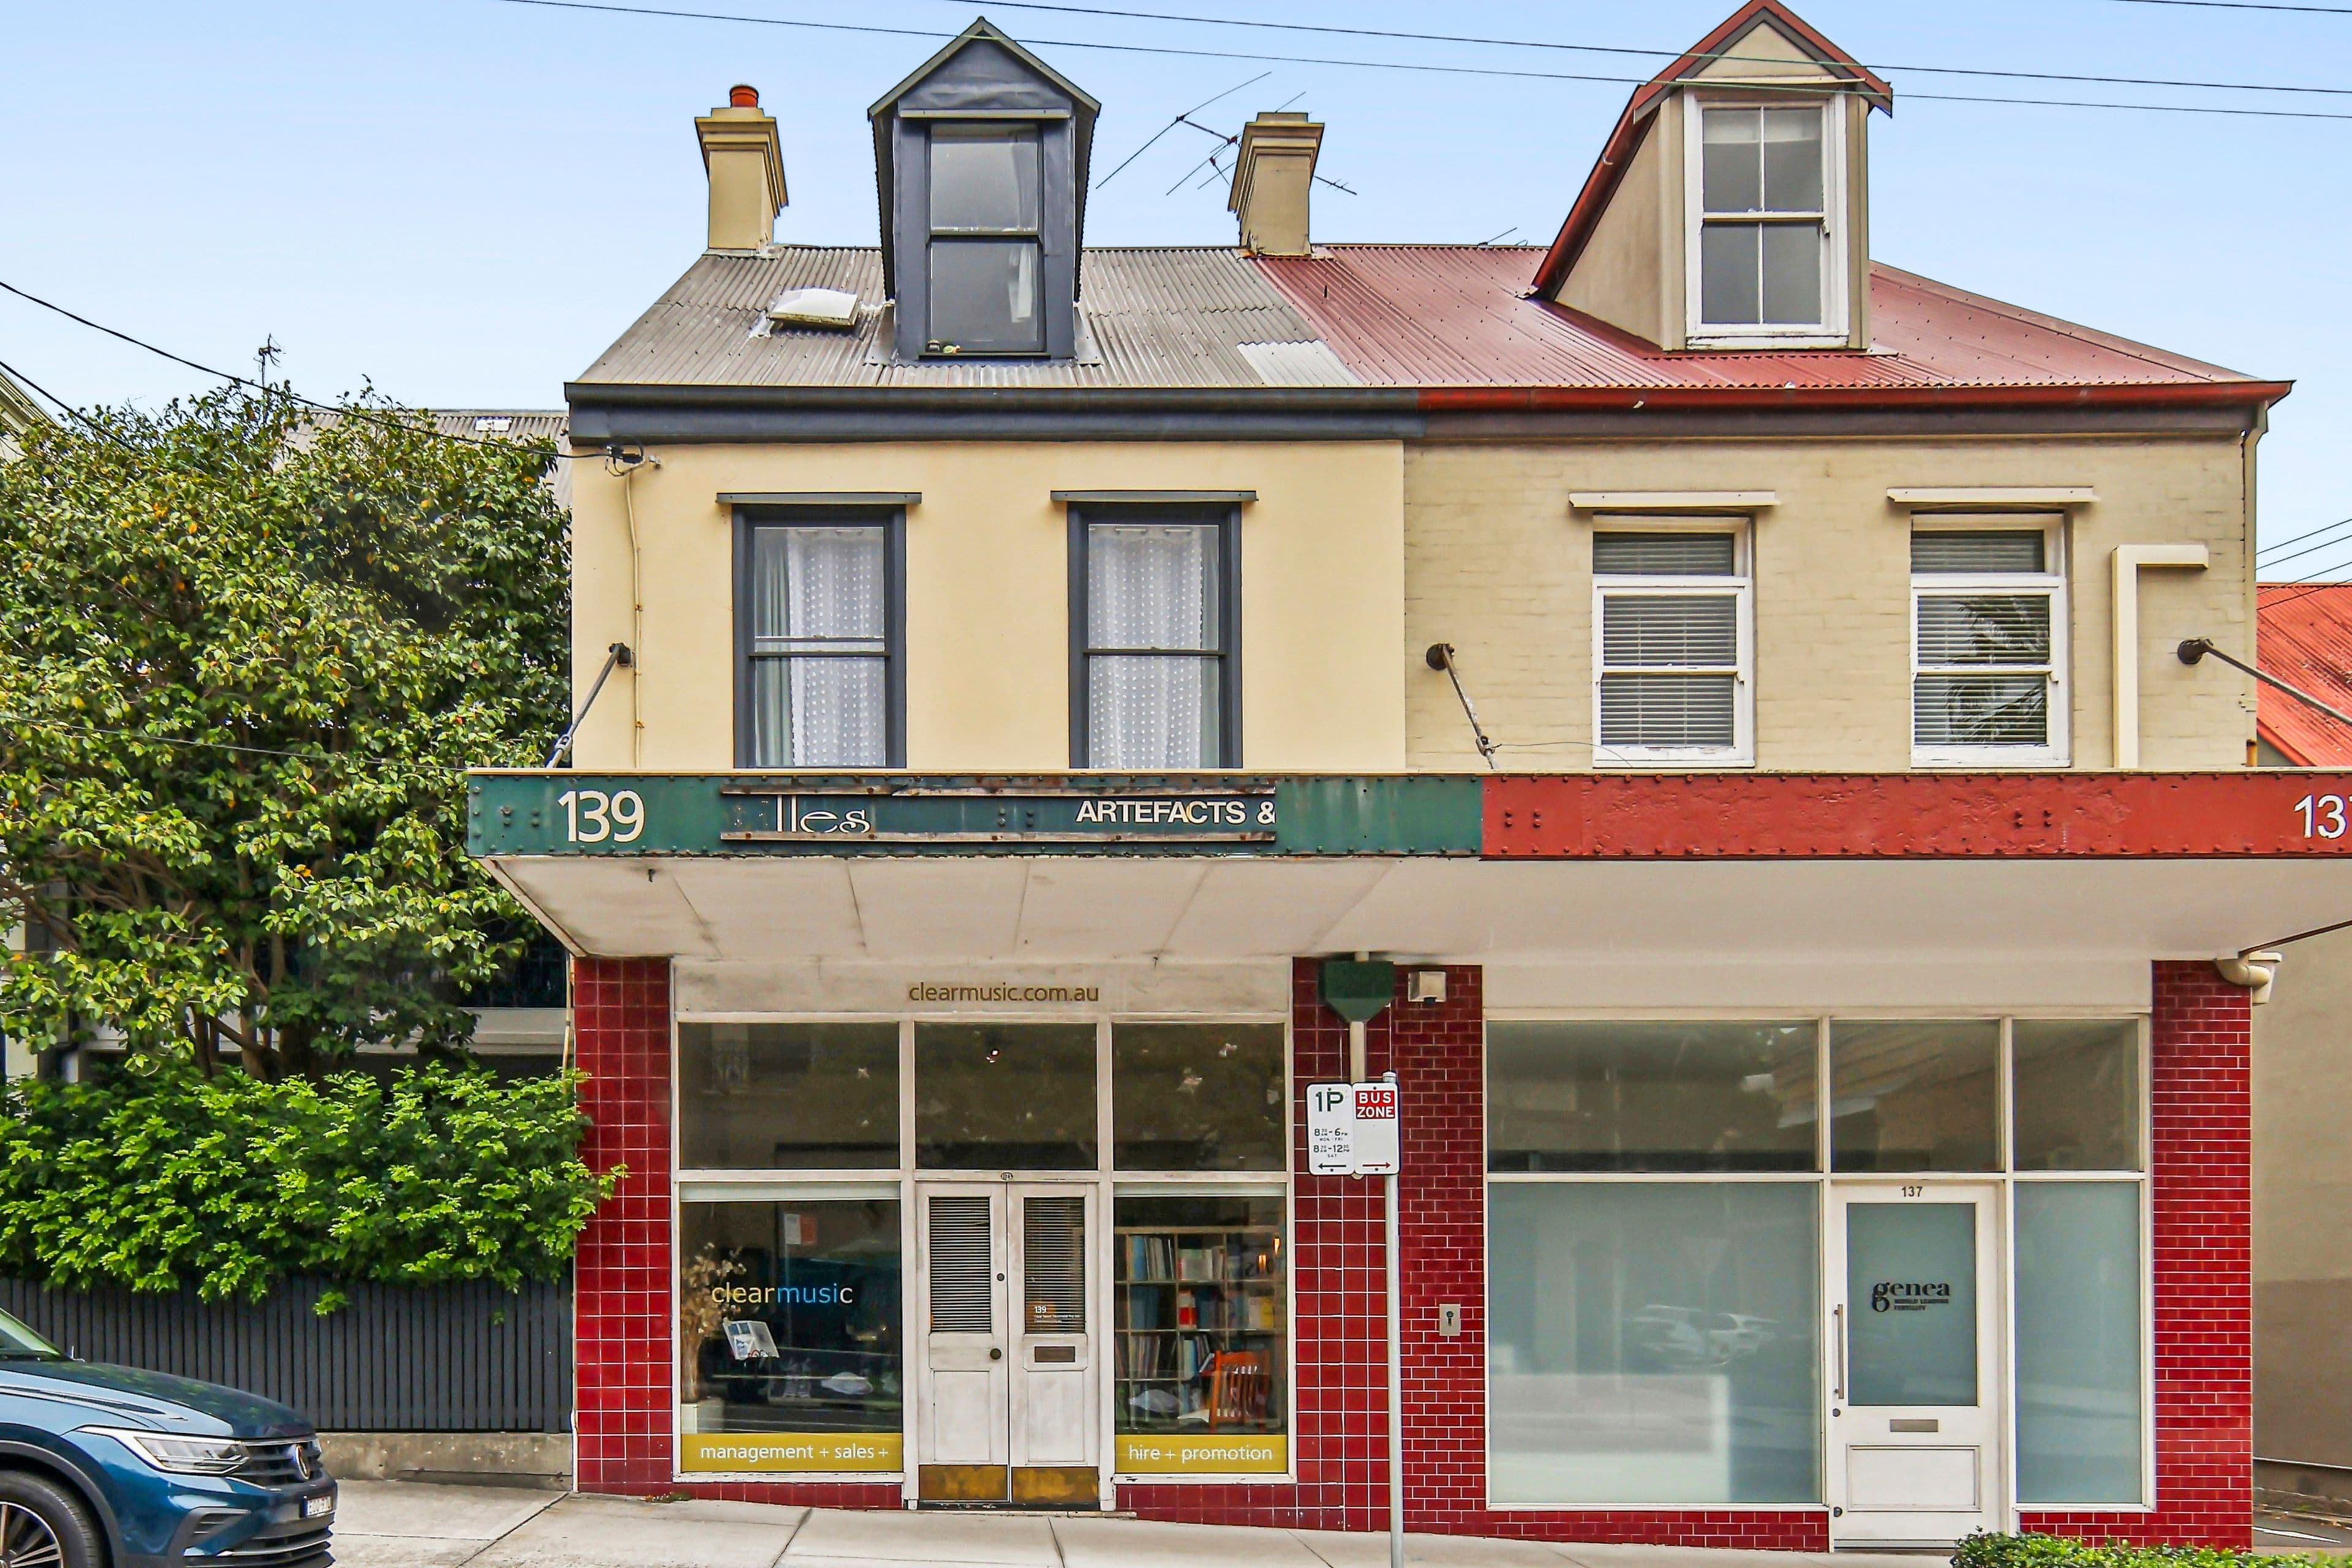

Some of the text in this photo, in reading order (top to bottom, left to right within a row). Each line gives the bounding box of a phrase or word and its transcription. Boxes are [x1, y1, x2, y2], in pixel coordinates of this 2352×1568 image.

[557, 790, 645, 843] 139
[1076, 800, 1276, 824] ARTEFACTS &
[2293, 794, 2352, 839] 13
[909, 981, 1099, 1001] clearmusic.com.au
[1315, 1091, 1344, 1112] 1P
[1359, 1091, 1392, 1104] BUS
[1357, 1106, 1394, 1118] ZONE
[1901, 1186, 1923, 1197] 137
[711, 1282, 853, 1305] clearmusic
[1872, 1282, 1950, 1312] genea
[700, 1444, 813, 1463] management
[835, 1443, 875, 1459] sales
[1128, 1444, 1161, 1461] hire
[1181, 1446, 1273, 1463] promotion
